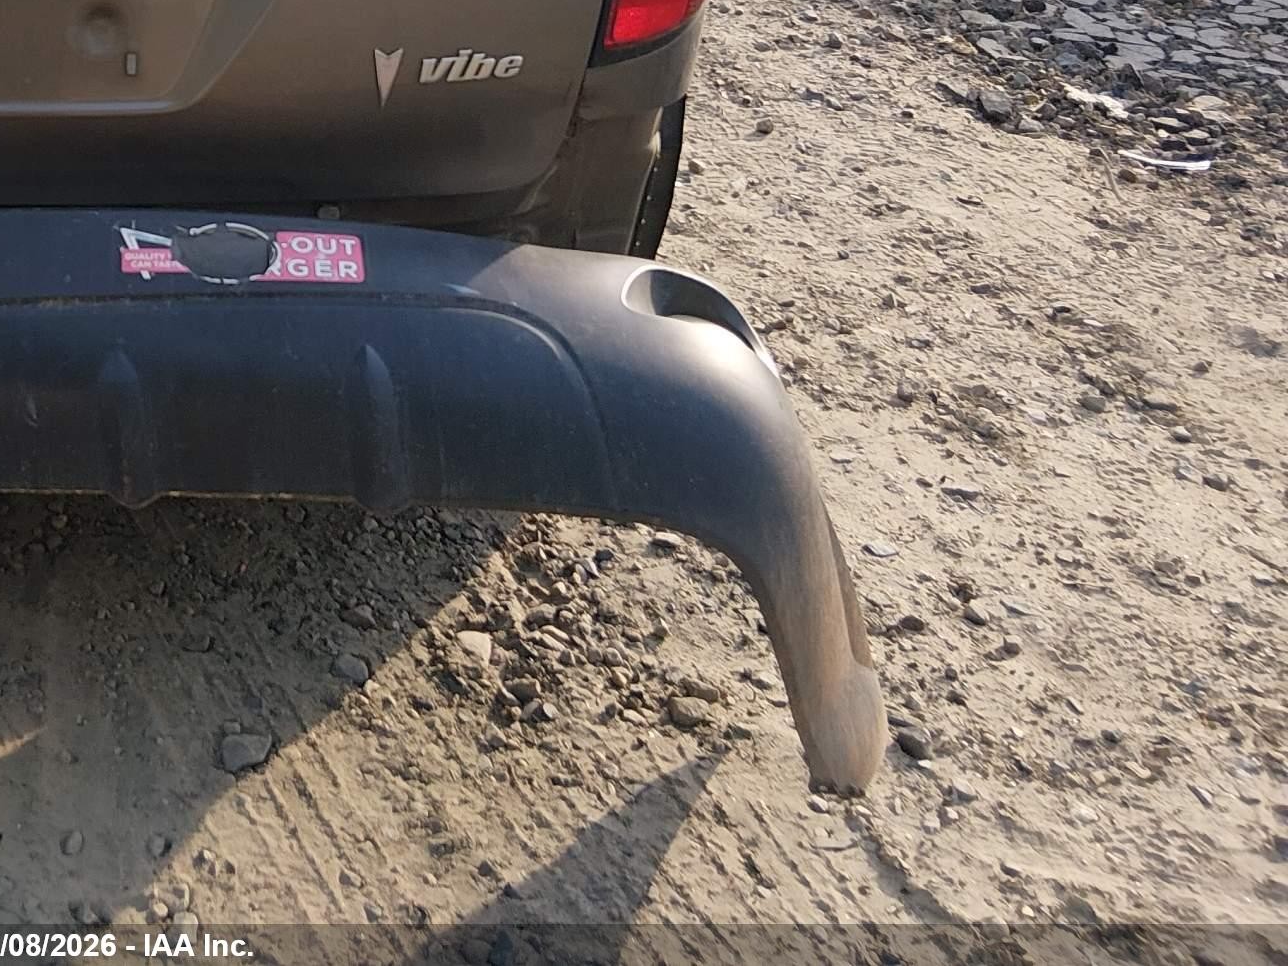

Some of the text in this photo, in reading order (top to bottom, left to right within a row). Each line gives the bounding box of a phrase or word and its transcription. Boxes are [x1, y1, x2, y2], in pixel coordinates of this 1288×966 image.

[419, 49, 523, 83] vibe
[124, 252, 166, 261] QUALITY
[130, 260, 152, 268] CAN
